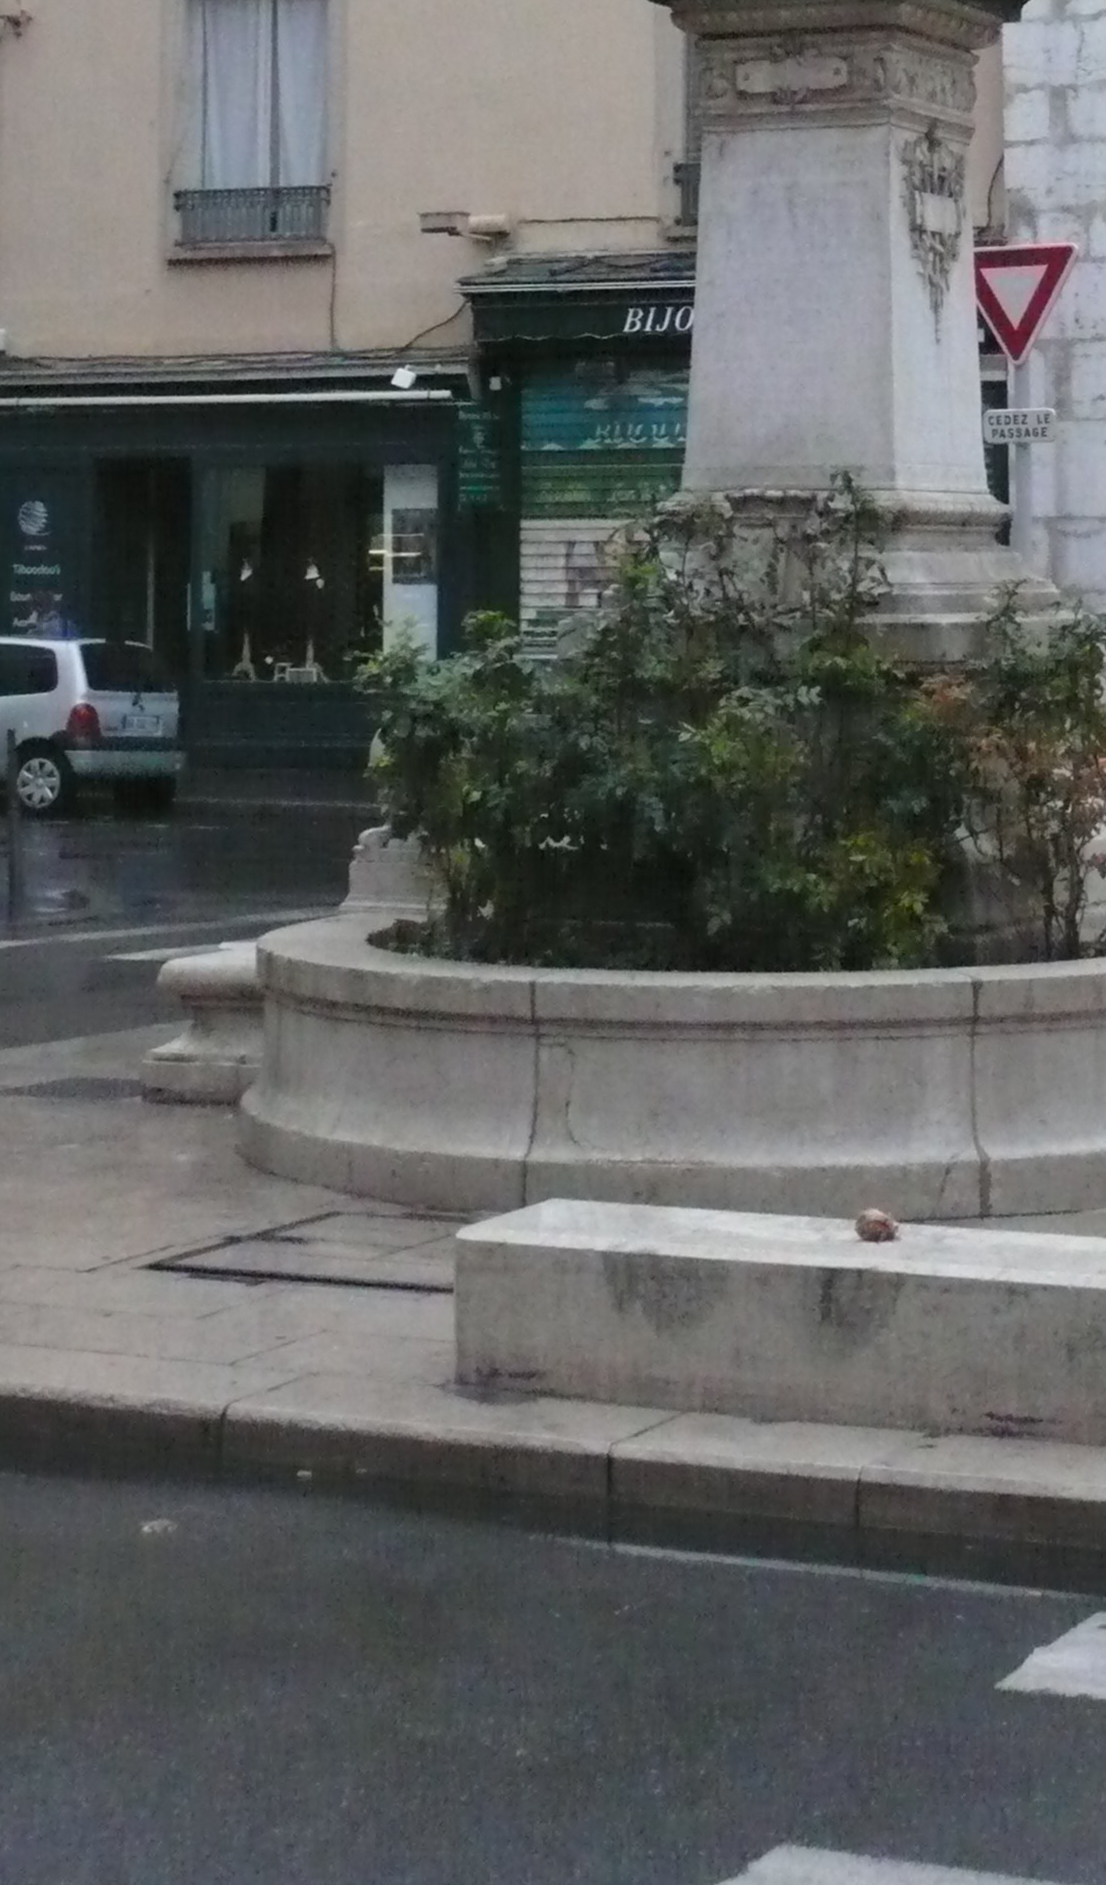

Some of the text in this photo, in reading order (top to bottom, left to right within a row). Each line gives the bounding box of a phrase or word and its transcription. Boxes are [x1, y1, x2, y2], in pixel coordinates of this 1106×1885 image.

[988, 413, 1051, 426] CEDEZ LE
[991, 427, 1048, 439] PASSAGE
